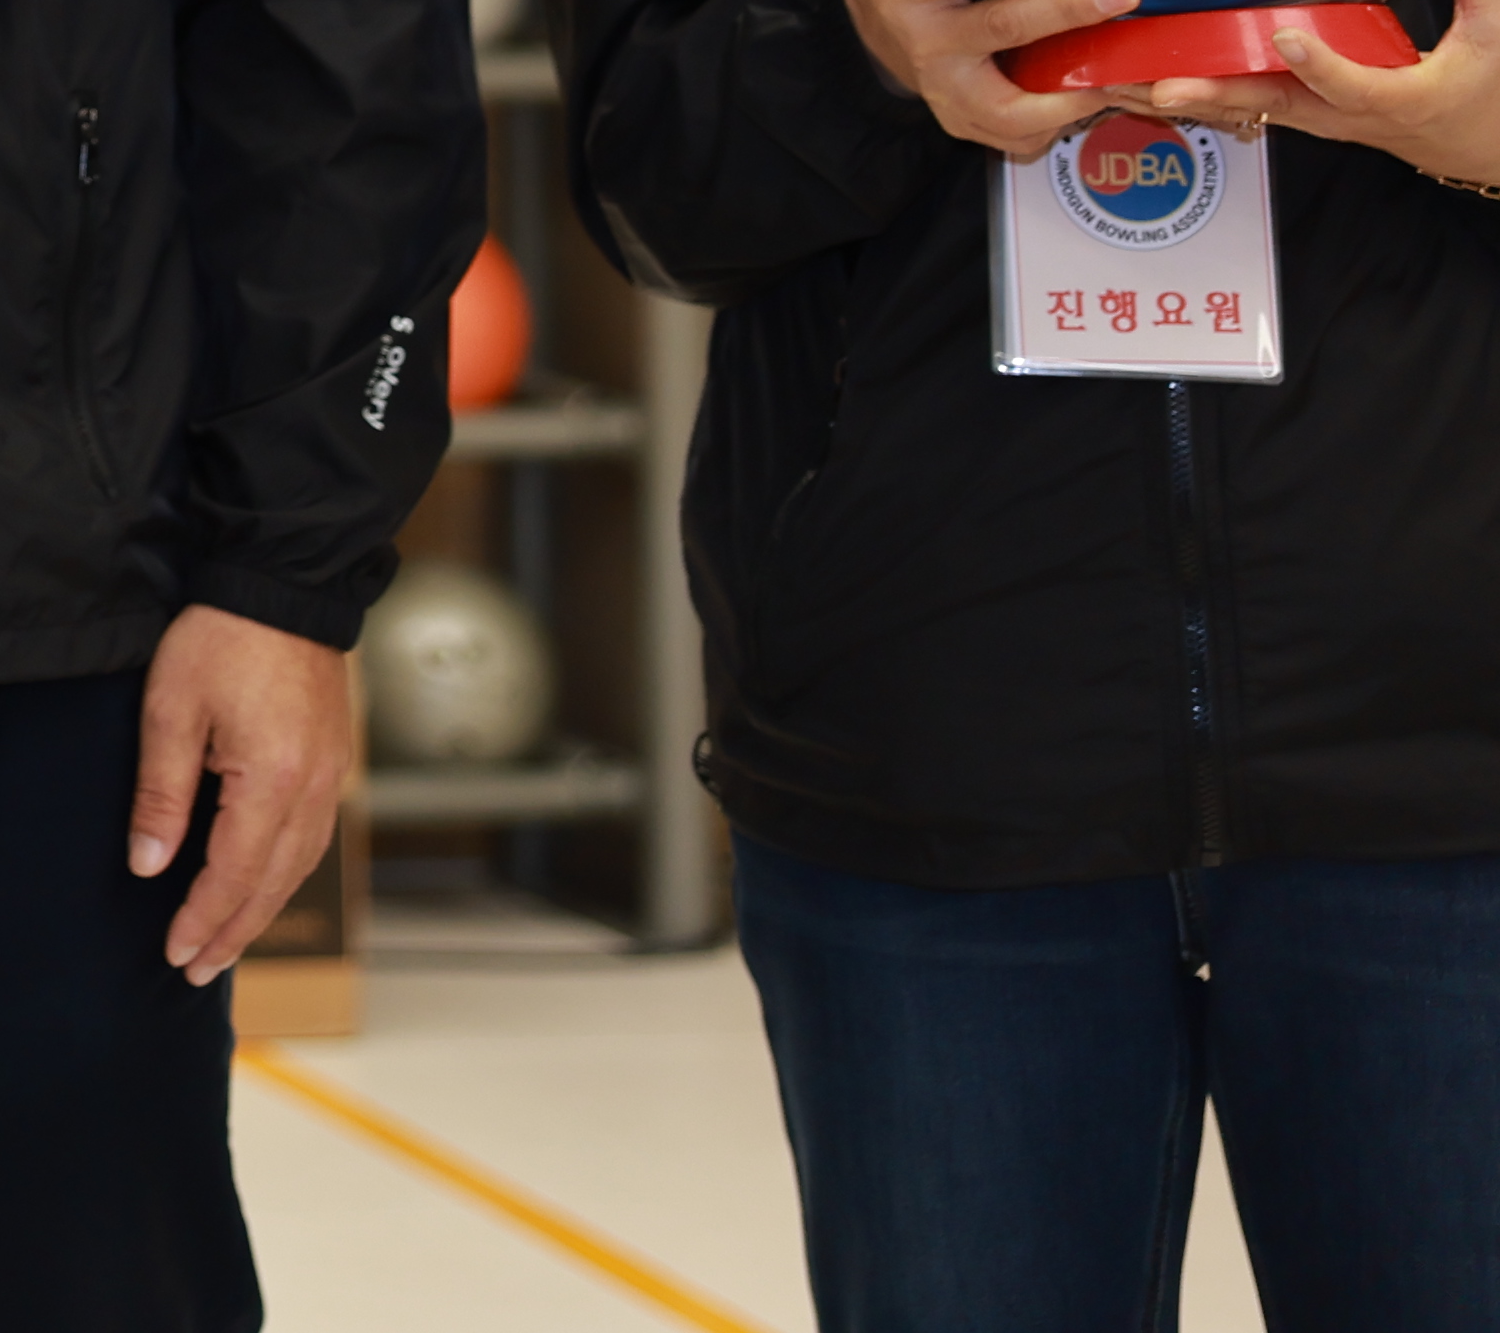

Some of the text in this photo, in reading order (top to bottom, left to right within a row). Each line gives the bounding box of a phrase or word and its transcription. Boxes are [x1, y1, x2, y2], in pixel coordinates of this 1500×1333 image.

[1085, 153, 1189, 187] JDBA
[1056, 150, 1219, 245] JINDOGUN BOWLING ASSOCIATION
[1047, 289, 1243, 334] 진행요원
